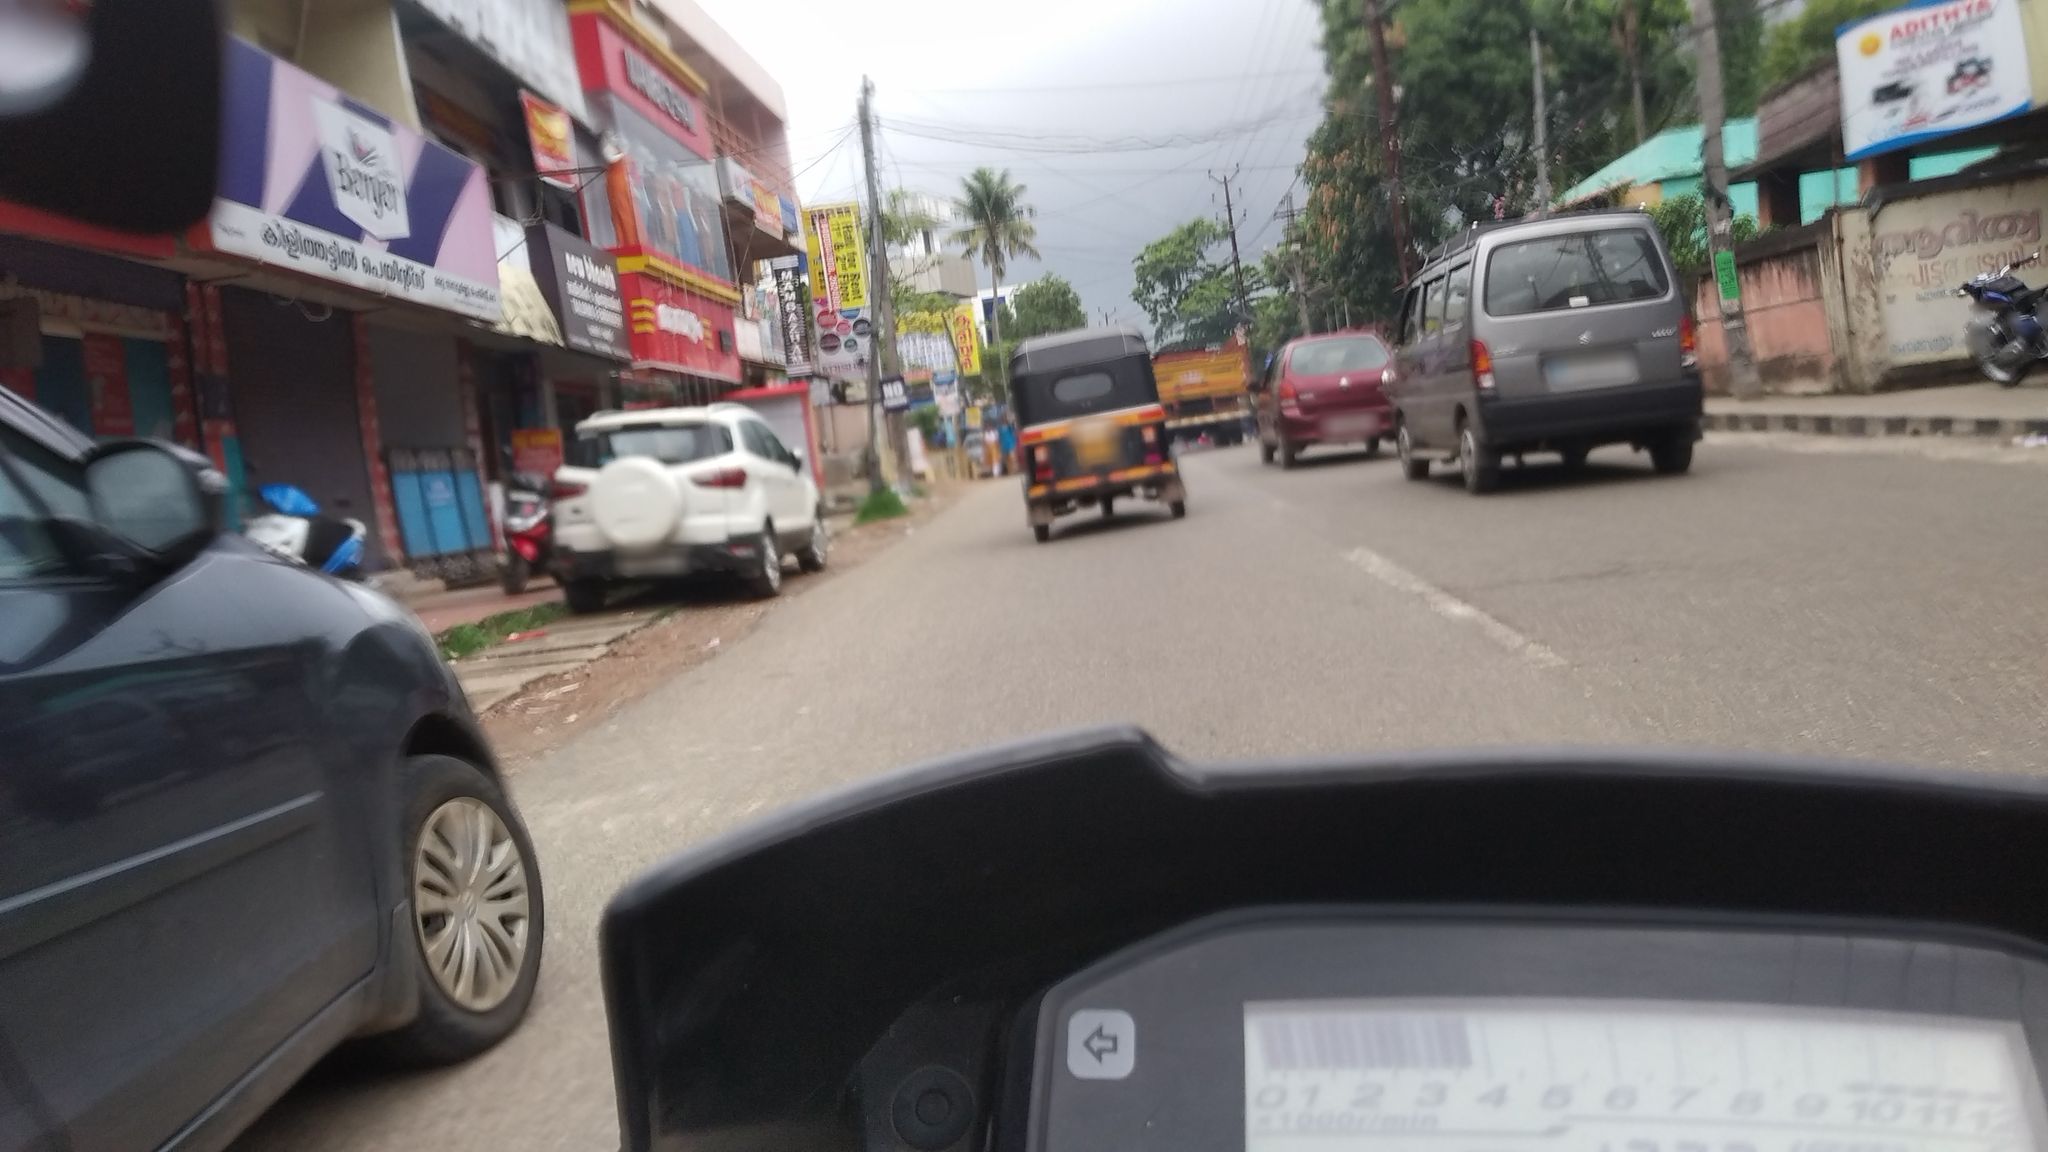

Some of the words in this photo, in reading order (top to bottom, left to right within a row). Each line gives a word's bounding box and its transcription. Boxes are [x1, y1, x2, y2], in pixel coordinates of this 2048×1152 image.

[1889, 1, 1991, 41] ADITHYA
[1350, 1082, 1385, 1109] 2
[1415, 1082, 1448, 1109] 3
[1476, 1083, 1509, 1109] 4
[1670, 1086, 1701, 1112] 7
